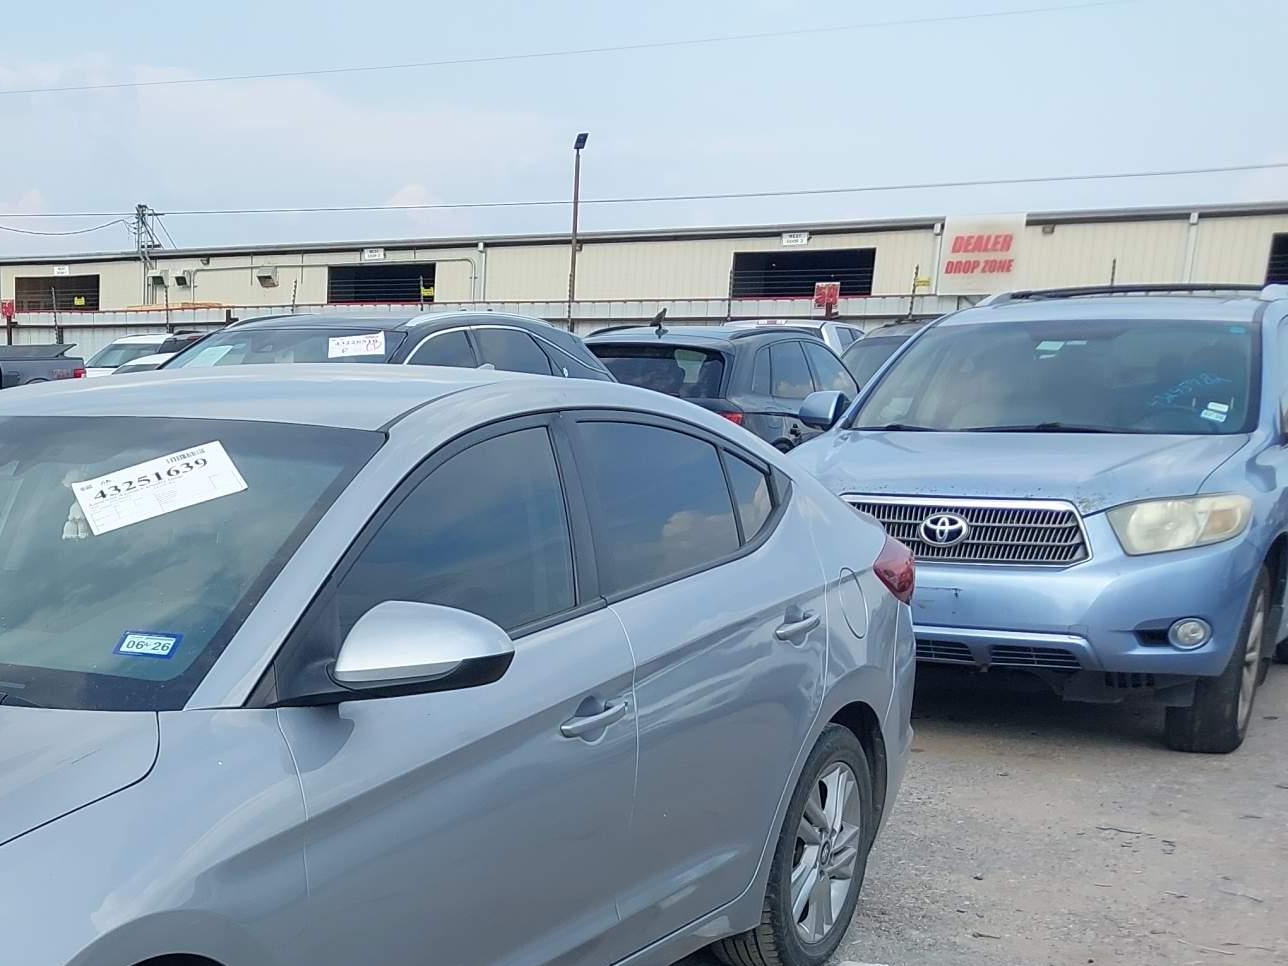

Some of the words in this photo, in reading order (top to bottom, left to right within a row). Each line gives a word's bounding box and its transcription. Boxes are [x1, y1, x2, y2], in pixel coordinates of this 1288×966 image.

[951, 234, 1014, 254] DEALER
[944, 260, 981, 275] DROP
[981, 259, 1015, 274] ZONE
[94, 457, 208, 500] 43251639
[126, 640, 145, 650] 06
[151, 641, 172, 652] 26
